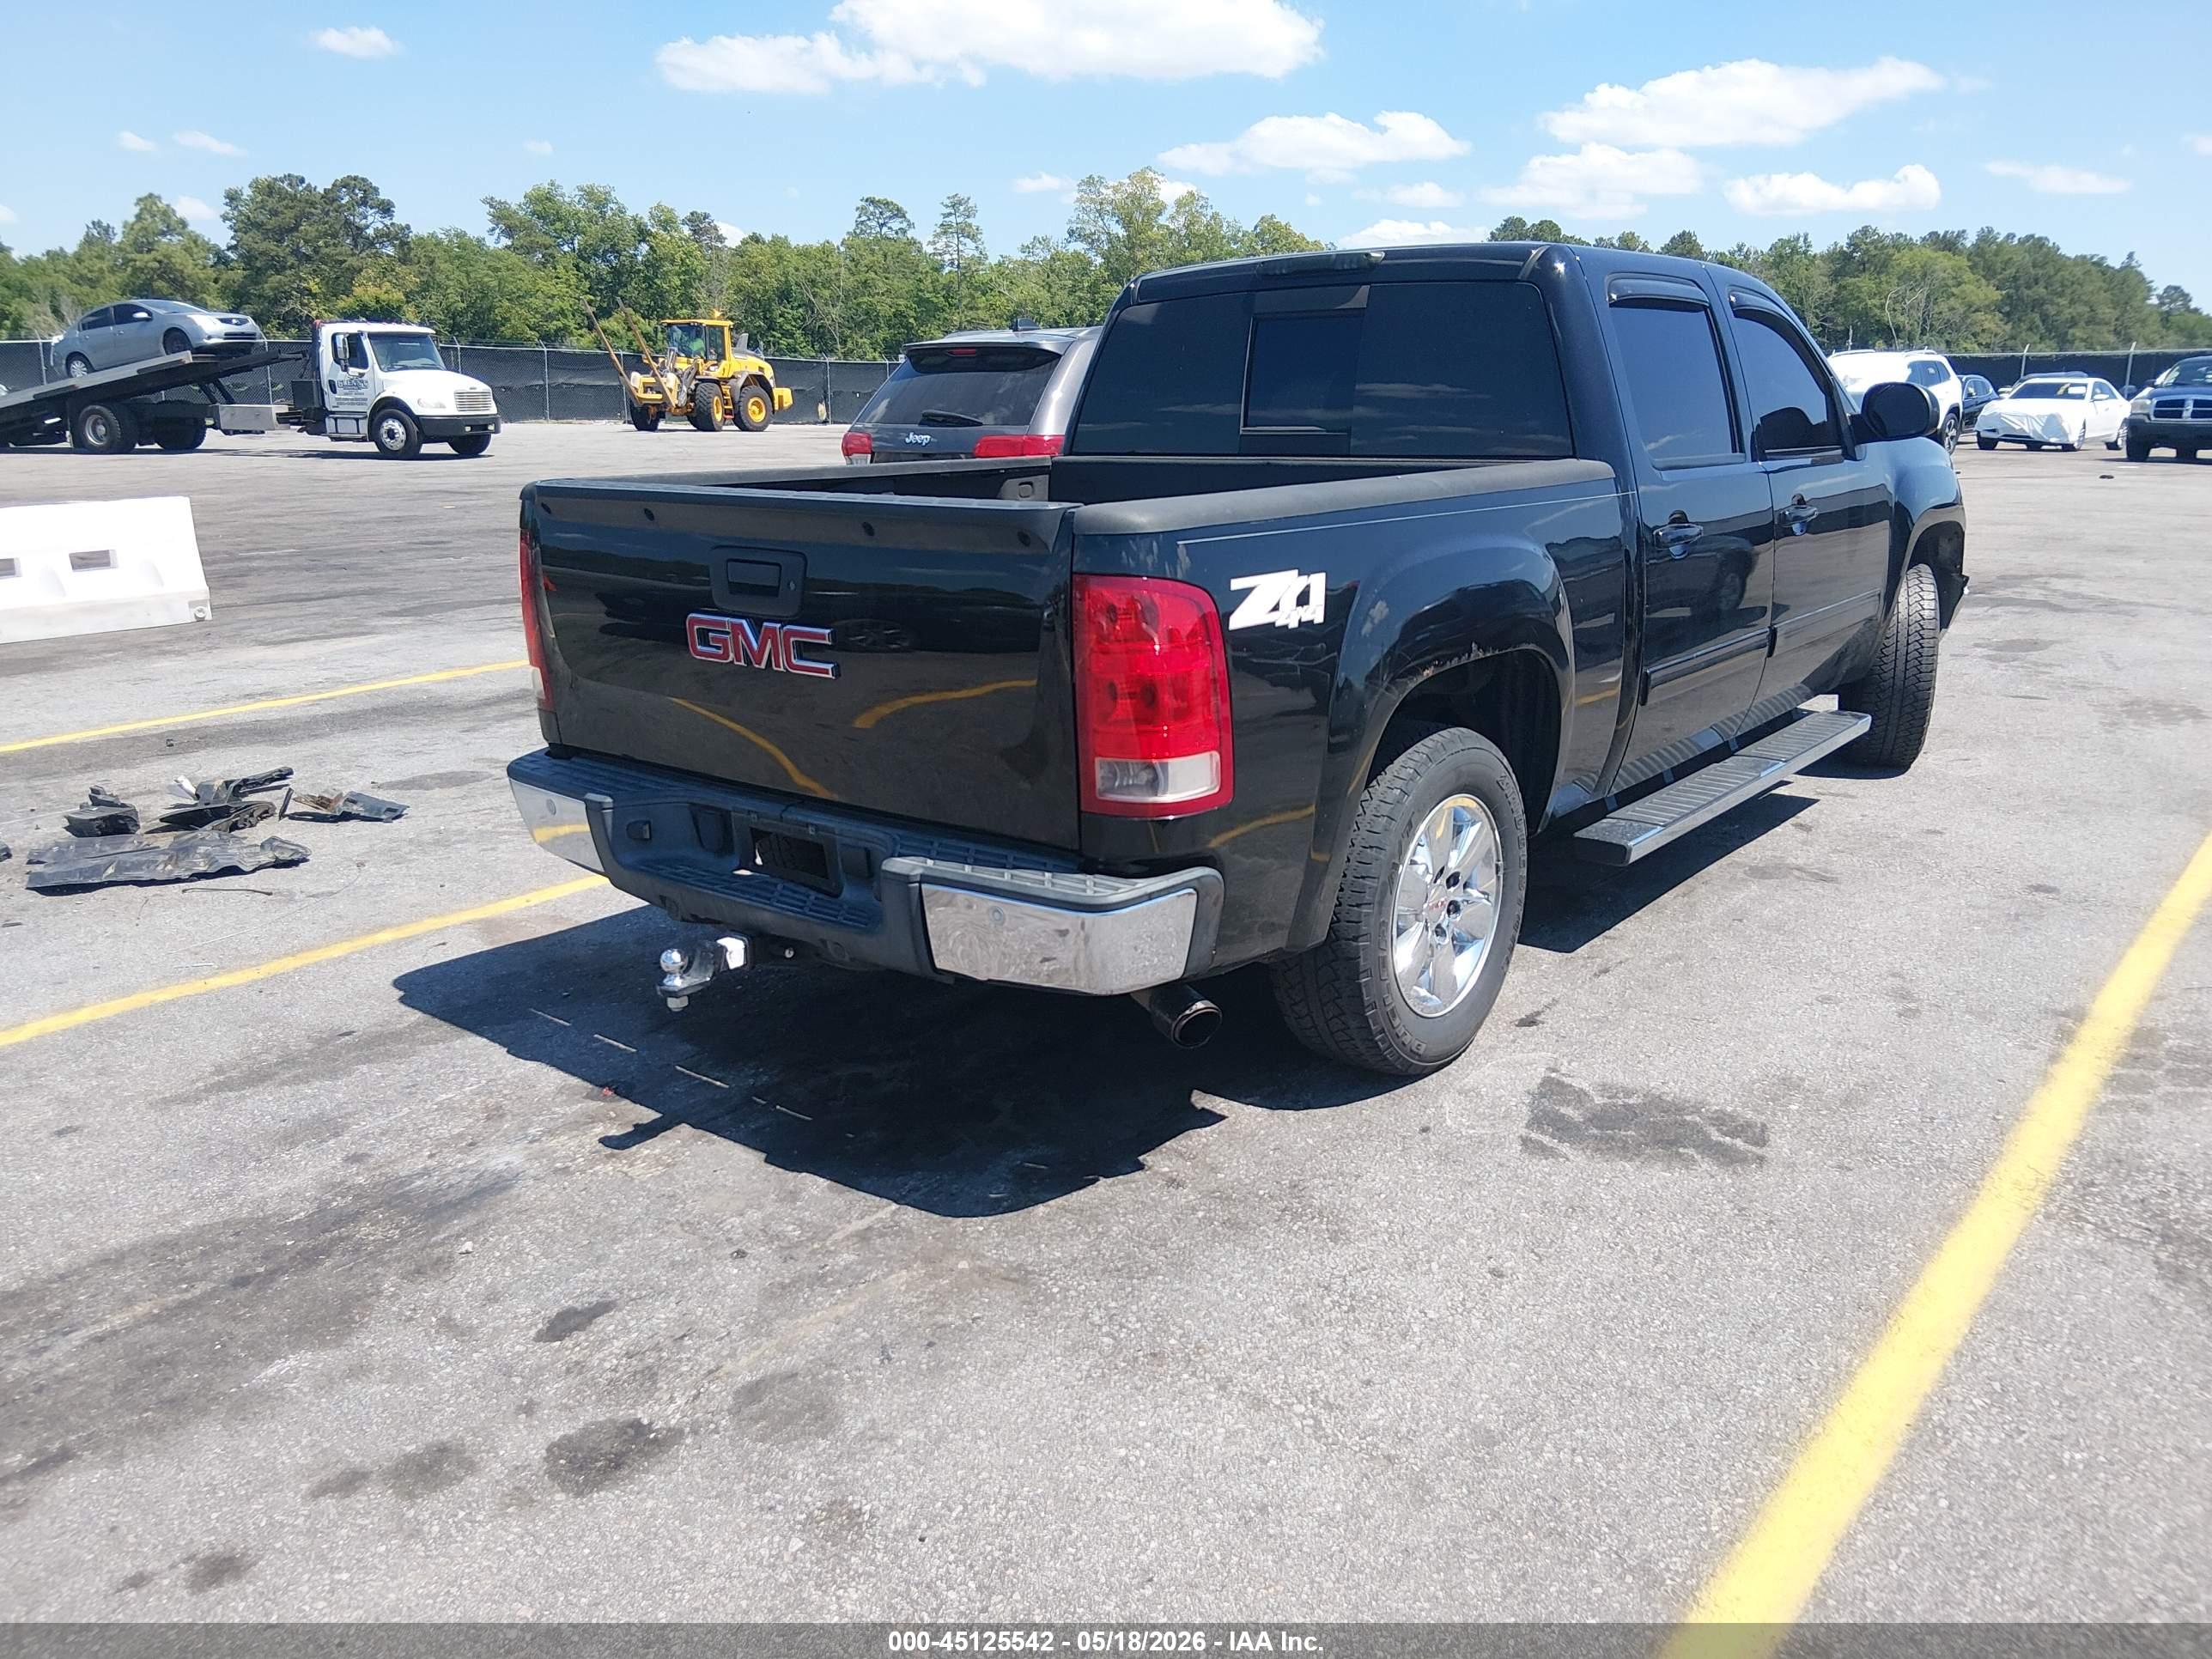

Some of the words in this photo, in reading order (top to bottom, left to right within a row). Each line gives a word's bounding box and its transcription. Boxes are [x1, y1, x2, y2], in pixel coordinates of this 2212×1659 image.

[904, 431, 932, 447] Jeep
[1229, 568, 1327, 630] Z71
[685, 611, 842, 680] GMC
